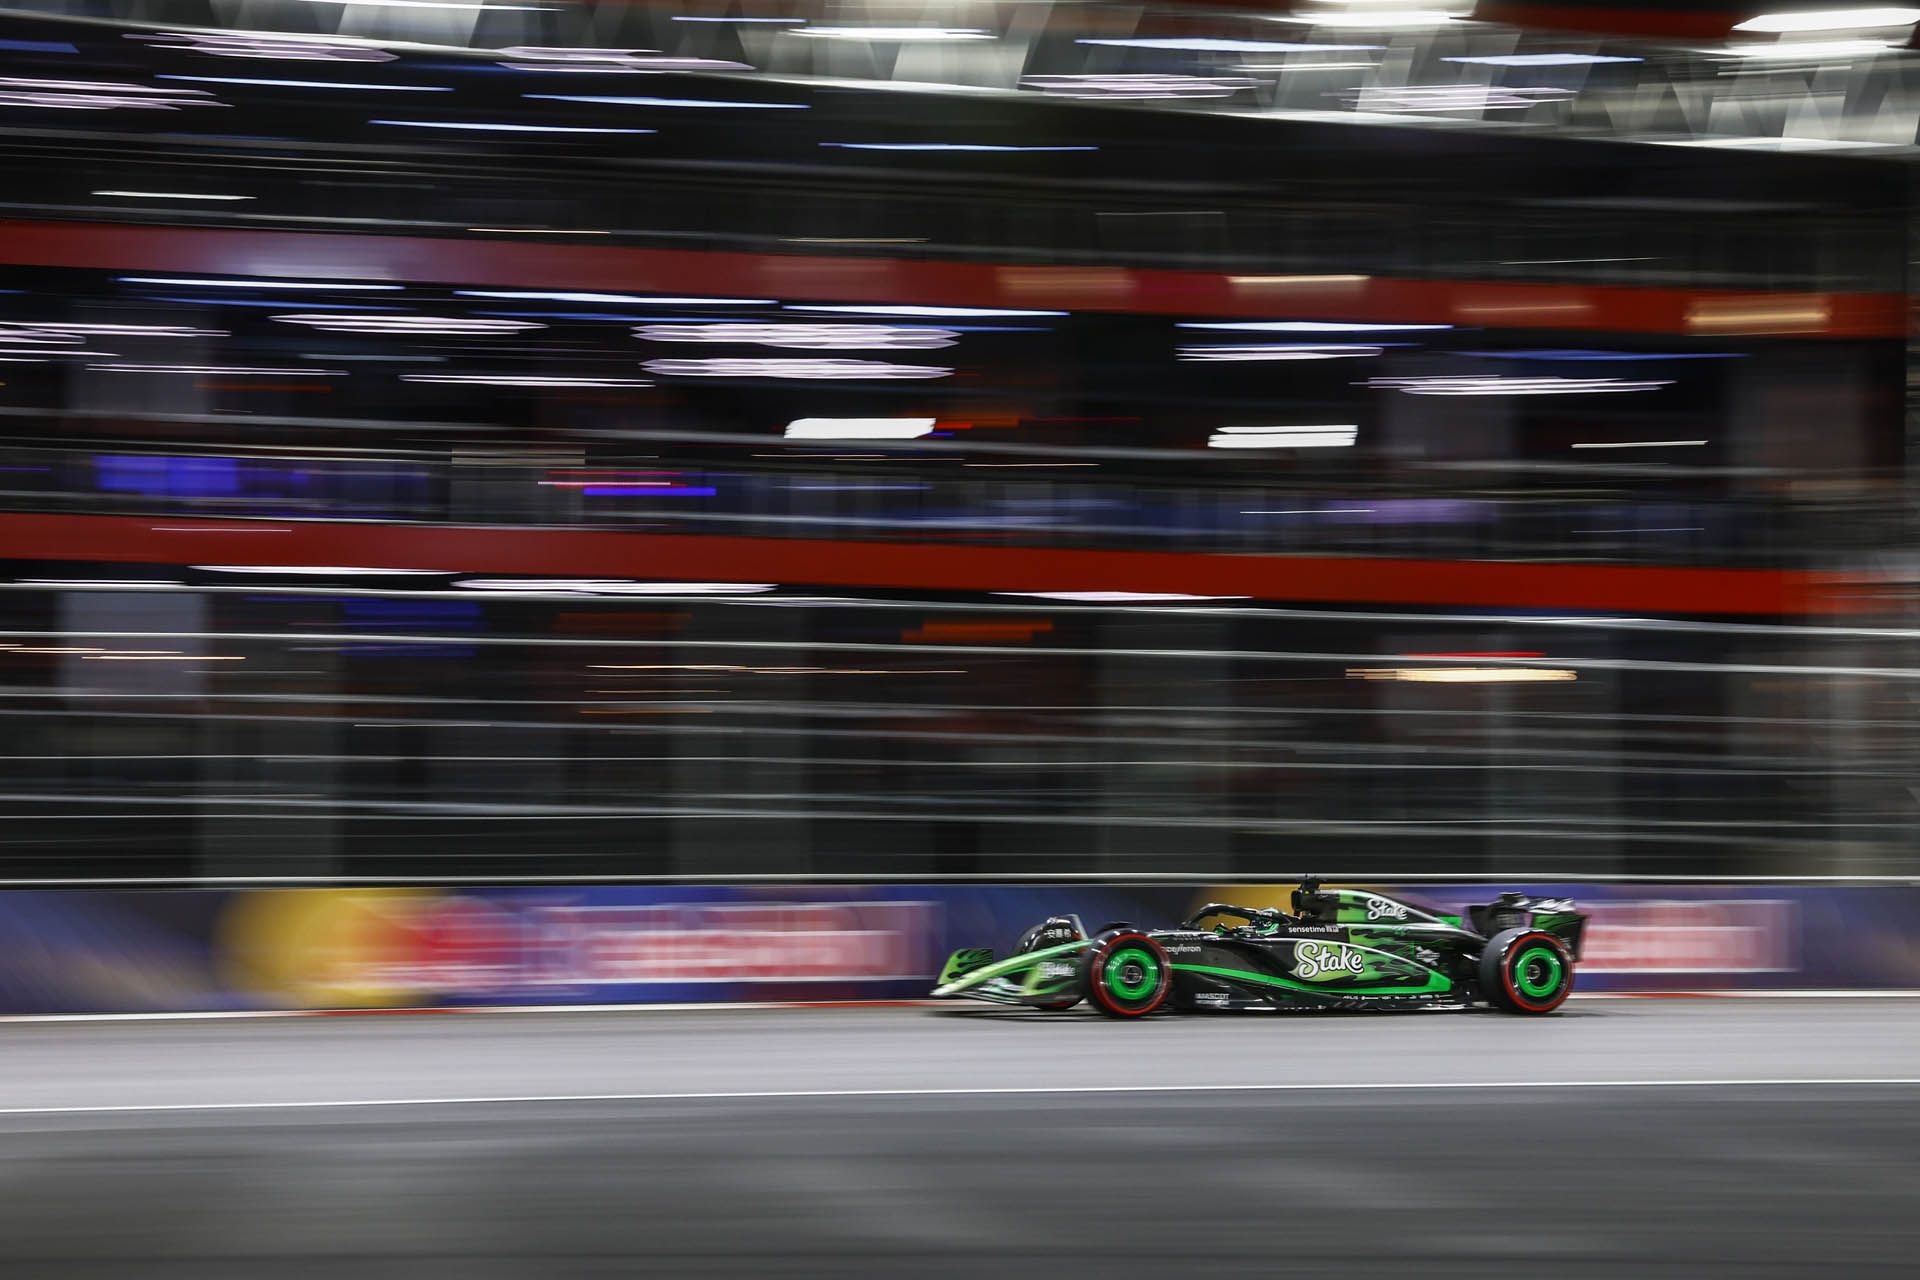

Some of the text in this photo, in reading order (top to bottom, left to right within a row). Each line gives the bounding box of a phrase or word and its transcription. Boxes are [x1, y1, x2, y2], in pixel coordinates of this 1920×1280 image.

[1367, 898, 1408, 920] Stake
[1288, 925, 1325, 933] sensetime
[1298, 942, 1364, 978] Stake
